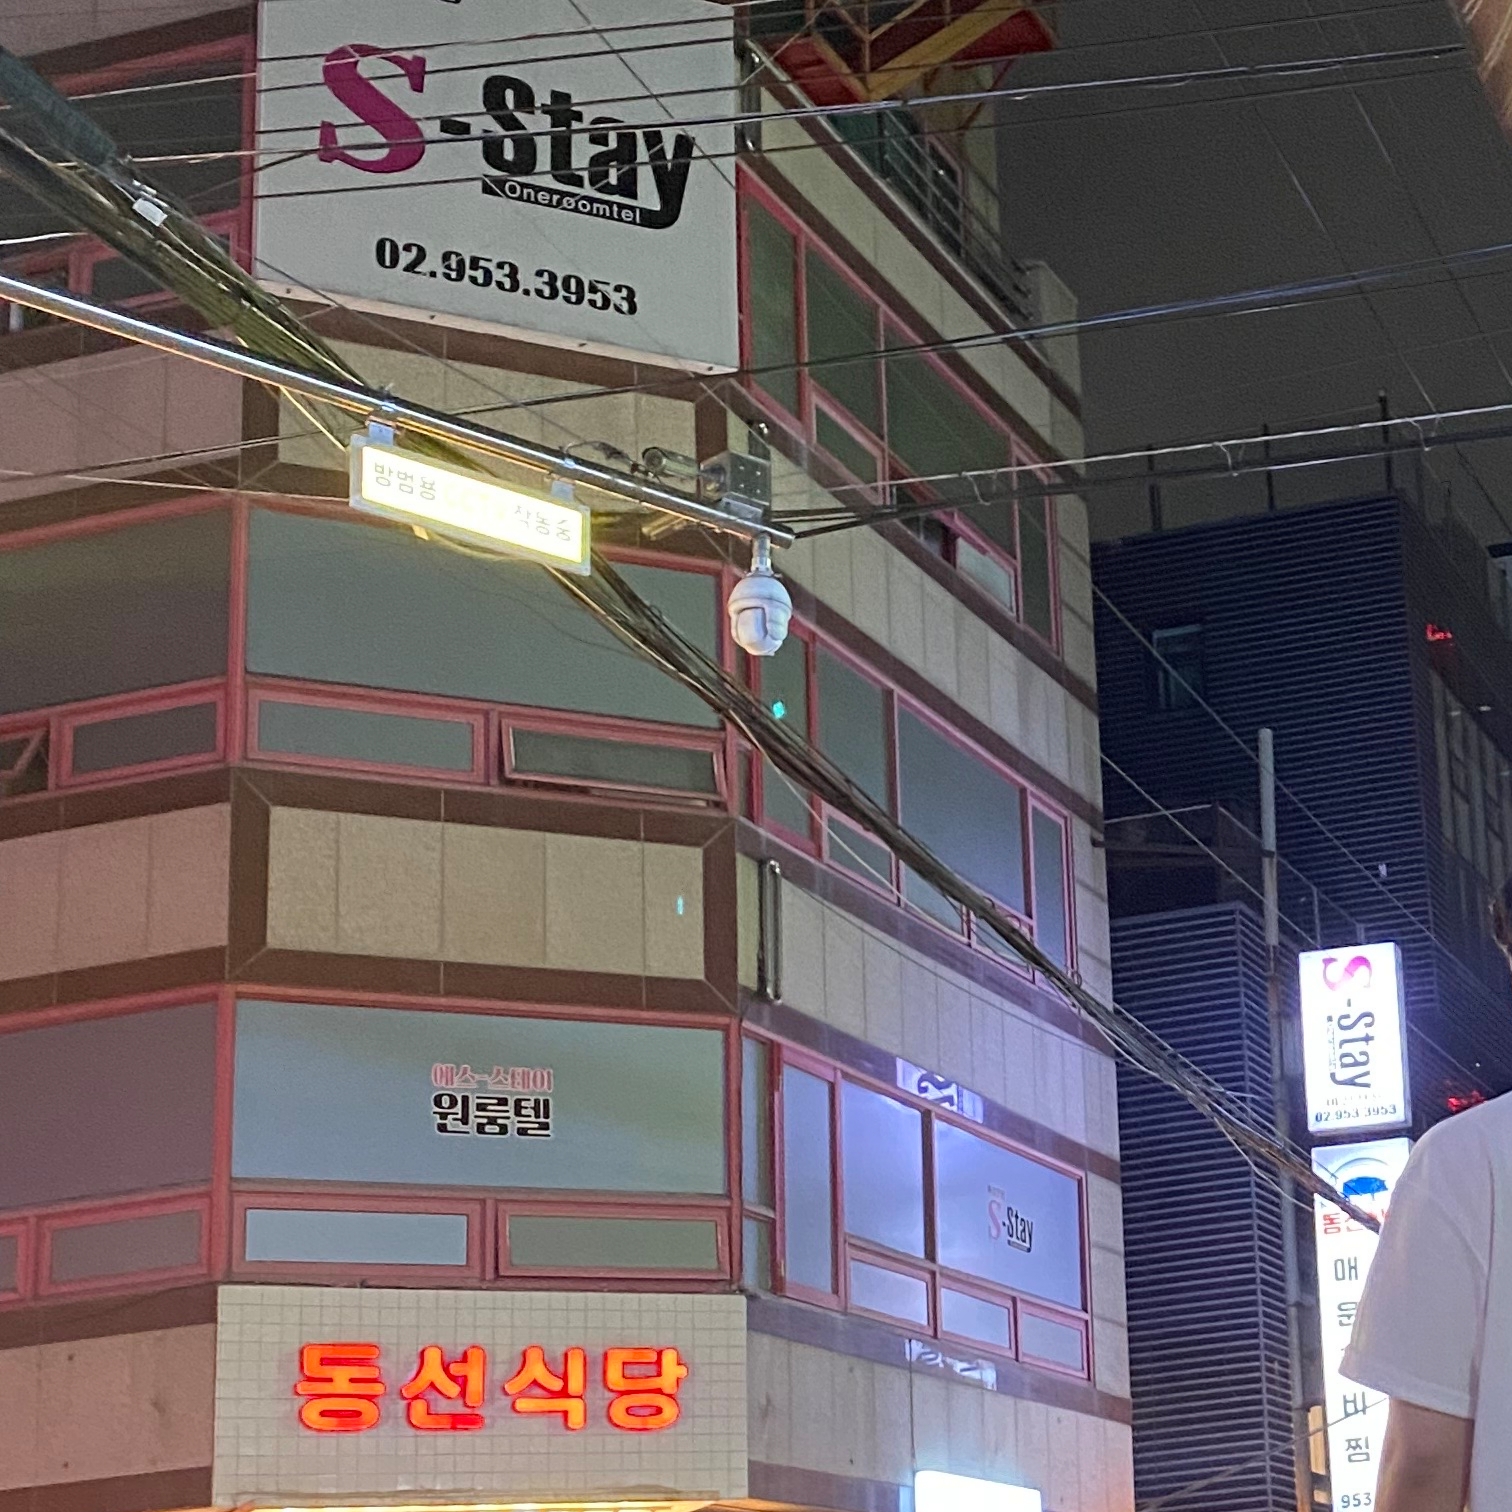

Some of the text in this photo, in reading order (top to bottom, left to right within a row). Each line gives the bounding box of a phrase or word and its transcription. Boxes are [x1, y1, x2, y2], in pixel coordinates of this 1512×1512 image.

[319, 43, 695, 230] S-Stay
[504, 179, 642, 224] Oneroomtel
[375, 236, 638, 316] 02.953.3953
[374, 461, 436, 501] 방범용
[1322, 955, 1375, 1088] S-Stay
[432, 1092, 552, 1138] 원룸텔
[294, 1342, 689, 1432] 동선식당
[1335, 1256, 1371, 1463] 매운비찜
